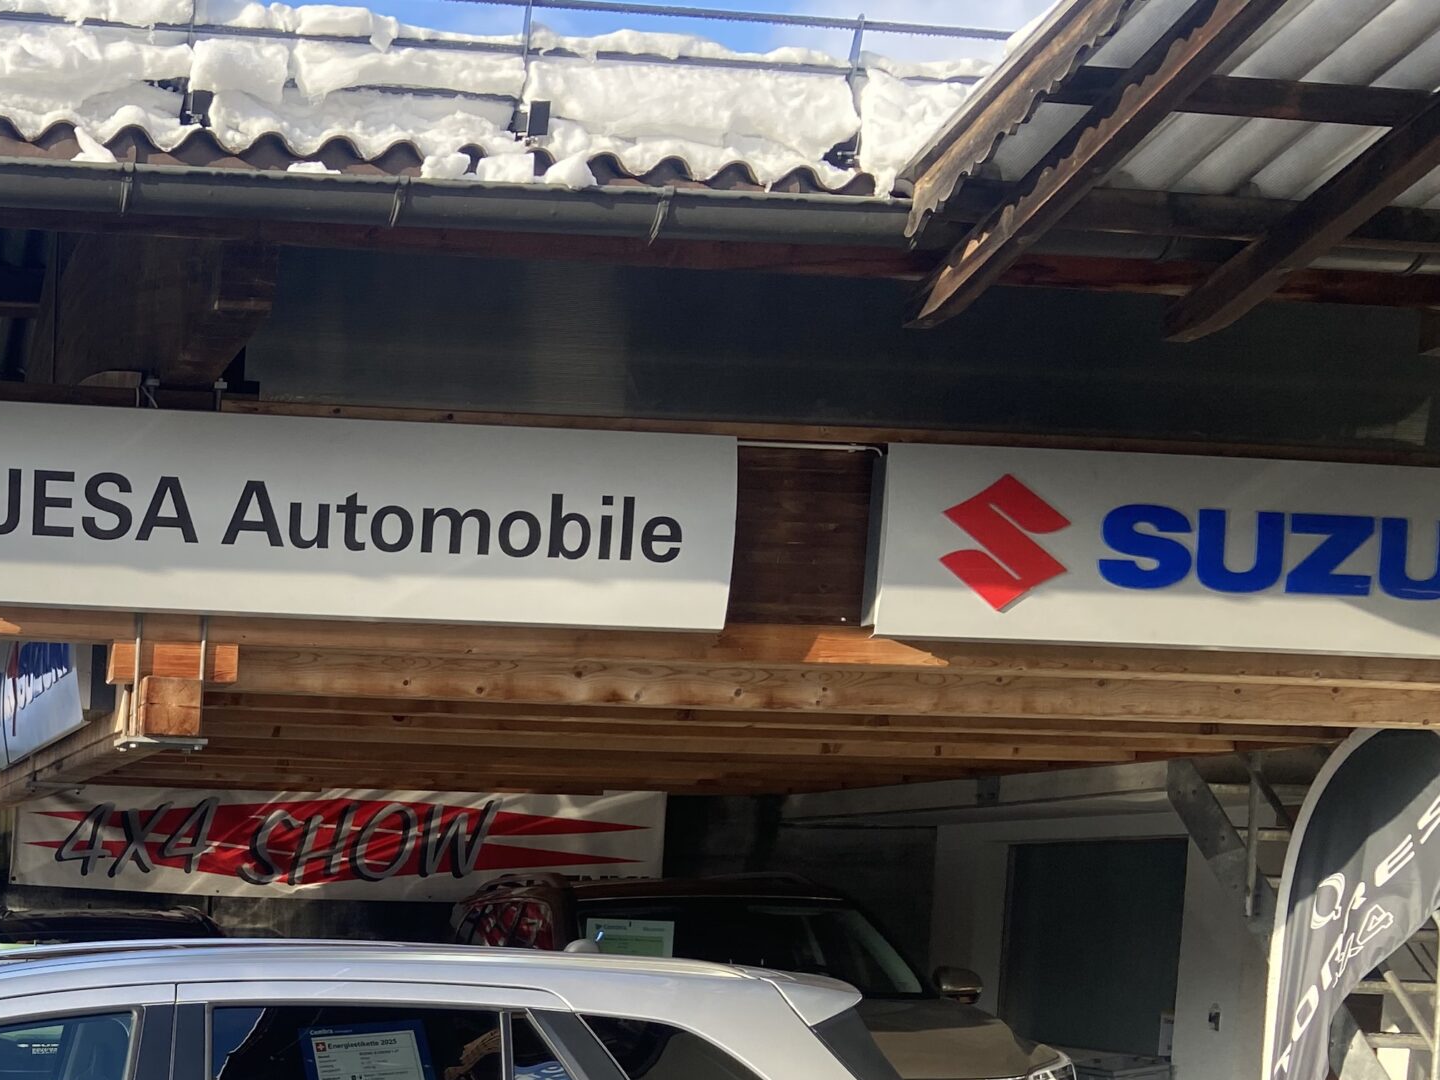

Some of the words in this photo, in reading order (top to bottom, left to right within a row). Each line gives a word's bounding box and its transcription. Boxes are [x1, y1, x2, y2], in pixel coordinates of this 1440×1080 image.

[220, 479, 684, 564] Automobile
[236, 798, 504, 886] SHOW
[380, 1038, 398, 1047] 2025
